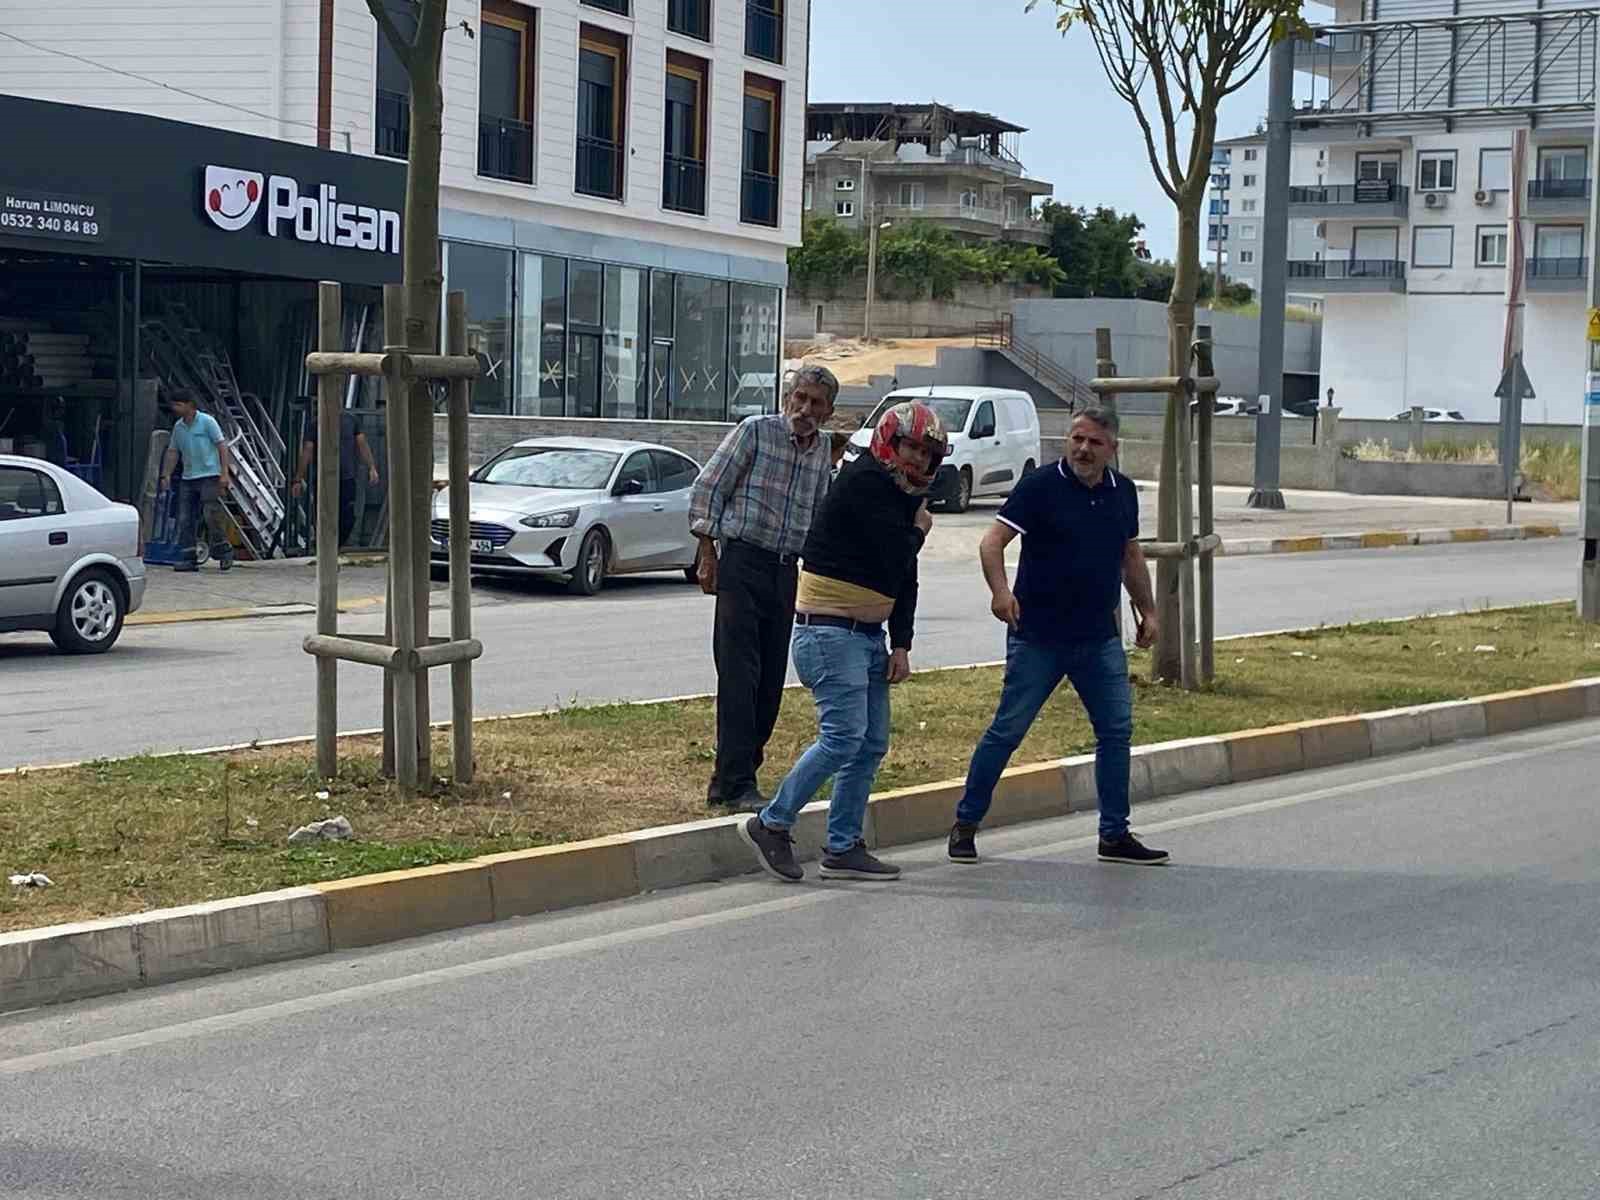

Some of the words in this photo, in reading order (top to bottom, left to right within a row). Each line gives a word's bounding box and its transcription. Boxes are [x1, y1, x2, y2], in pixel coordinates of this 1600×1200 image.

[6, 196, 40, 211] Harun
[267, 174, 400, 254] Polisan
[1, 212, 33, 228] 0532
[37, 216, 60, 231] 340
[63, 219, 79, 233] 84
[82, 221, 98, 235] 89
